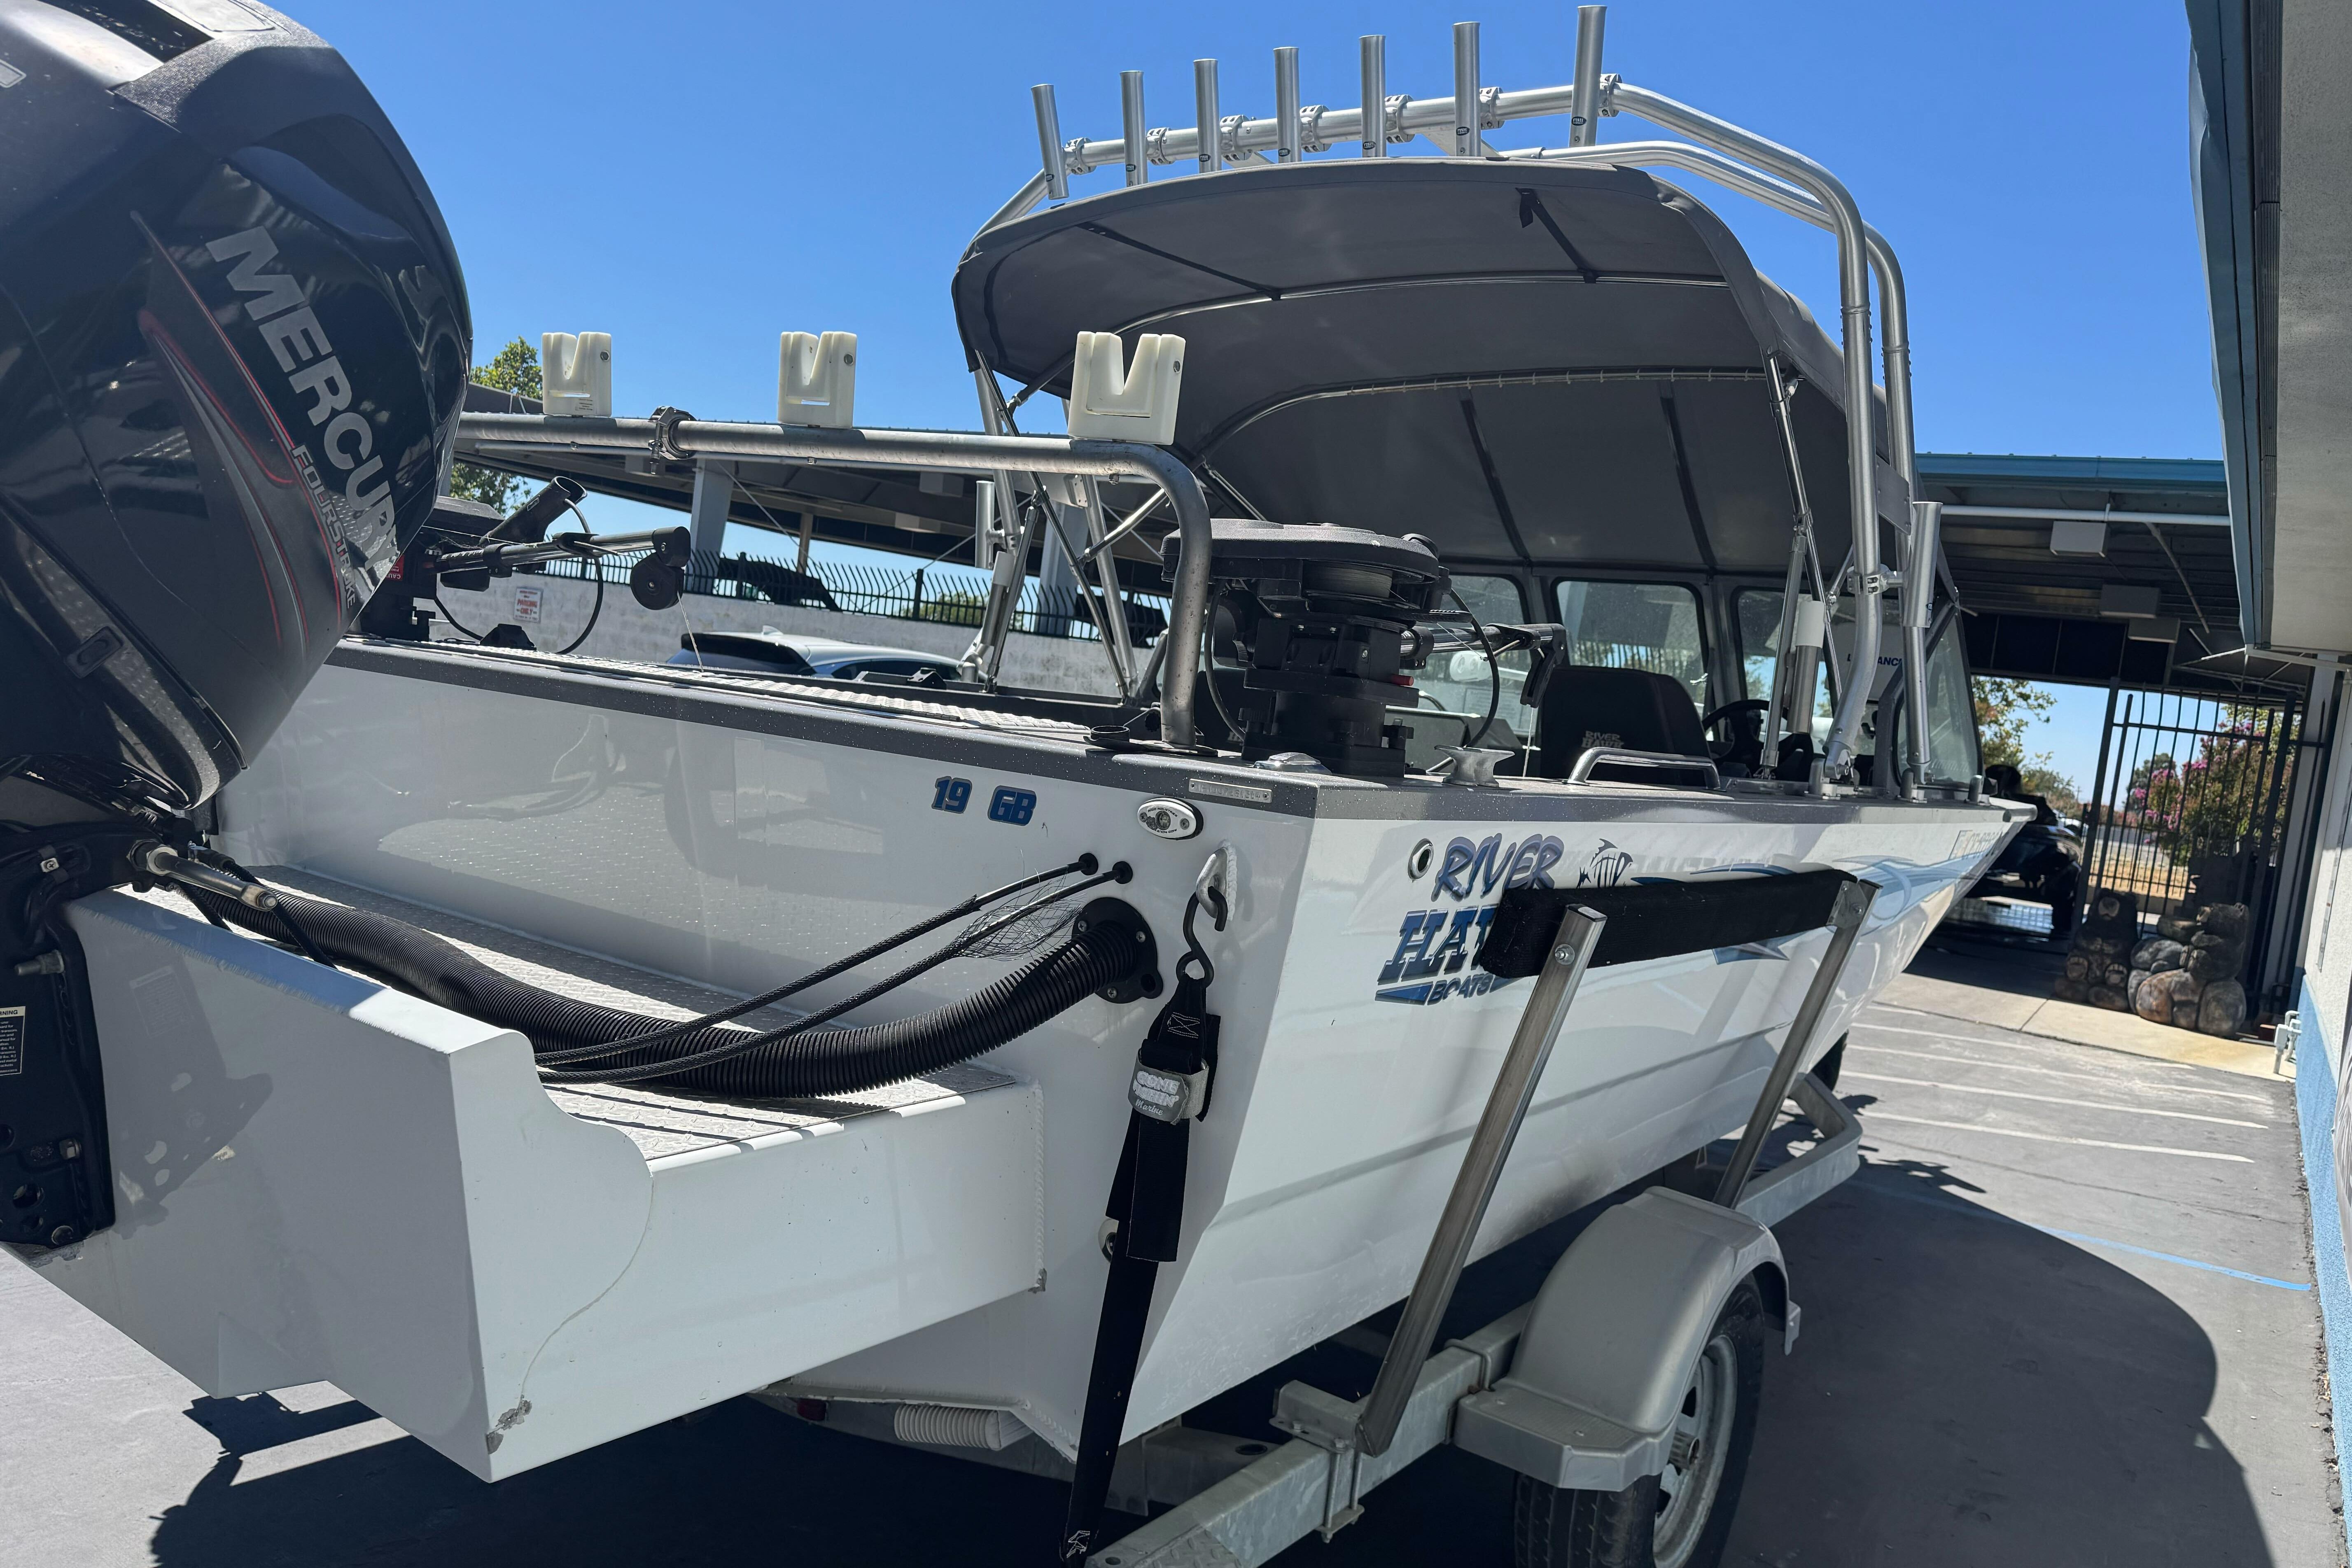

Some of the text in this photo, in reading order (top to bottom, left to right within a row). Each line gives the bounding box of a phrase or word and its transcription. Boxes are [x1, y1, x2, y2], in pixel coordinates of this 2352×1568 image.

[206, 226, 397, 571] MERCURY
[292, 445, 355, 609] FOURSTROKE
[1847, 653, 1902, 666] LANC
[1585, 730, 1622, 742] RIVER
[931, 776, 1037, 826] 19 GB
[1431, 833, 1564, 902] RIVER
[1377, 903, 1499, 978] HA
[1427, 973, 1496, 1006] BOATS
[1136, 1071, 1180, 1095] GONE
[1136, 1098, 1164, 1115] Marine
